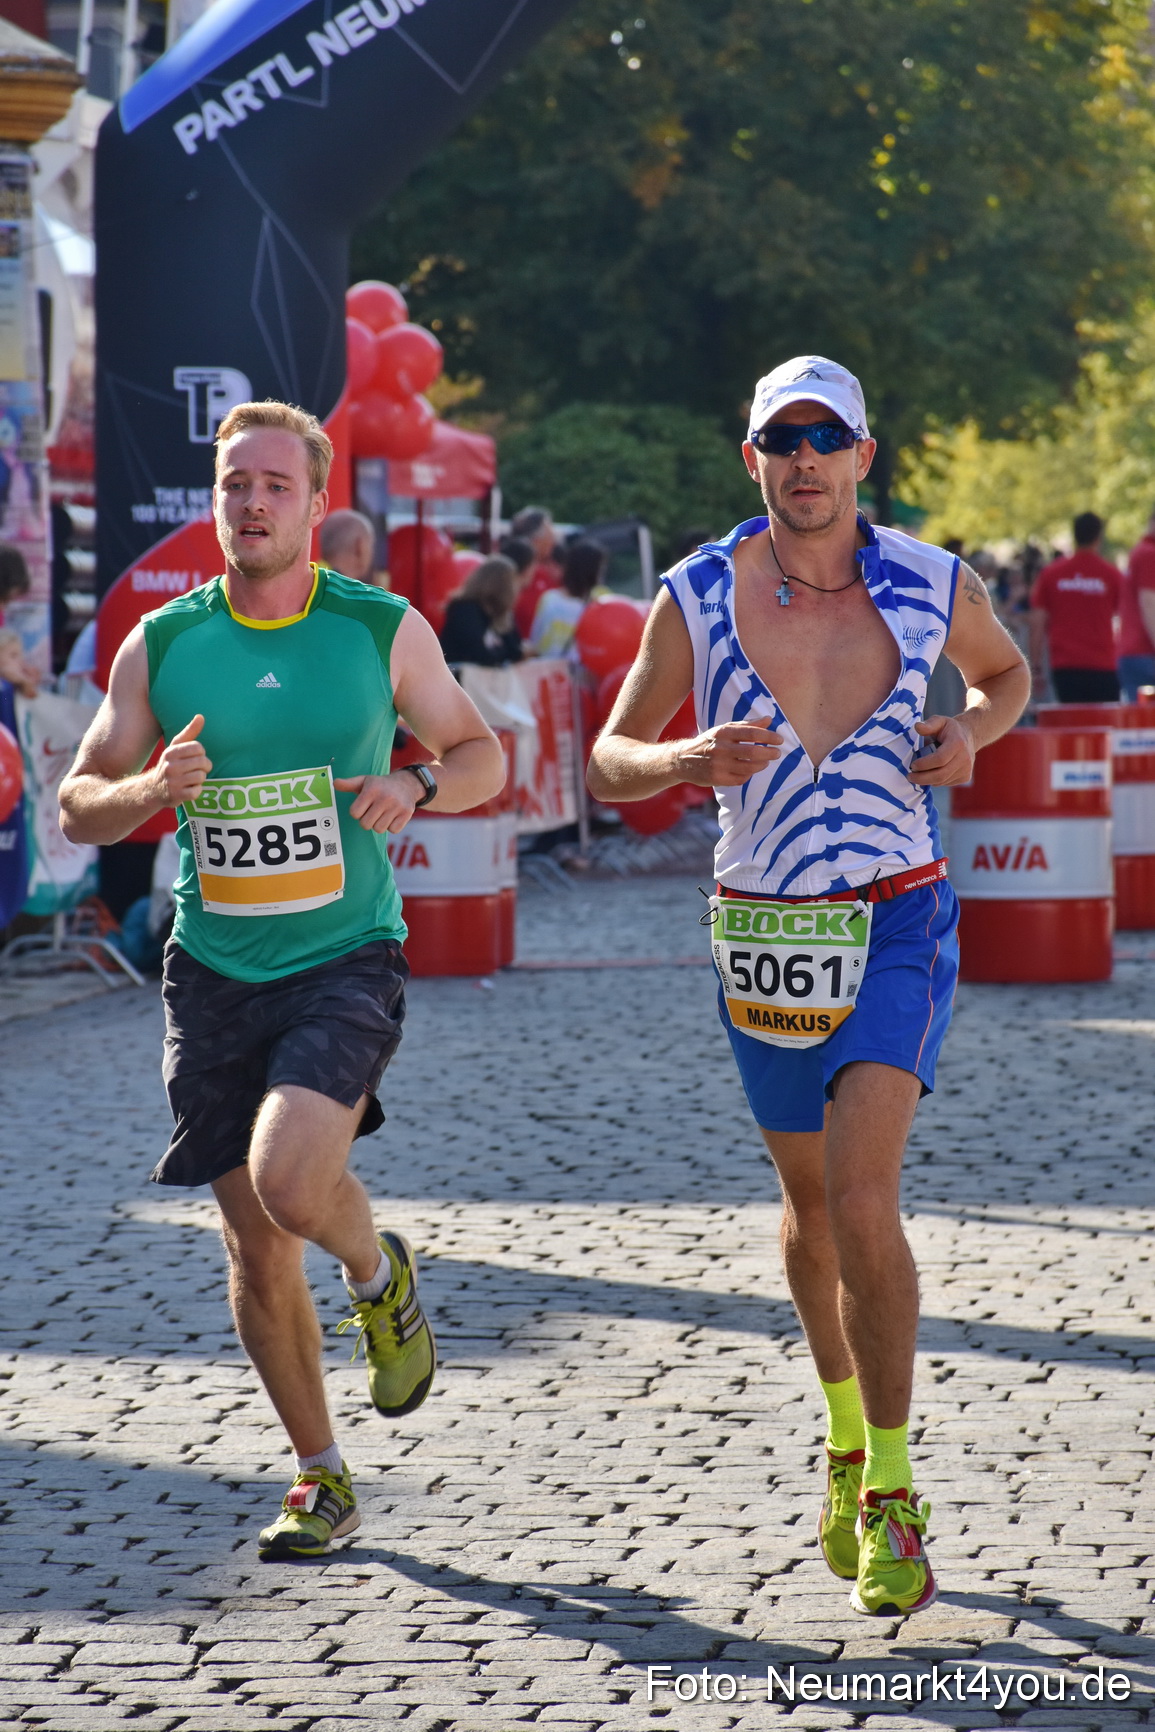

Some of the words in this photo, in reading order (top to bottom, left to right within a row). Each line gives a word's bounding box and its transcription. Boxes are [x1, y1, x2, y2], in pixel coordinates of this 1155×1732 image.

[171, 52, 316, 155] PARTL
[305, 0, 427, 66] NEU
[153, 487, 185, 505] THE
[187, 487, 213, 505] NE
[131, 504, 157, 523] 100
[132, 569, 189, 593] BMW
[195, 776, 319, 815] BOCK
[205, 819, 321, 868] 5285
[904, 882, 917, 890] new
[916, 874, 937, 886] balance
[724, 905, 853, 940] BOCK
[729, 950, 843, 998] 5061
[853, 958, 860, 968] S
[747, 1007, 831, 1032] MARKUS
